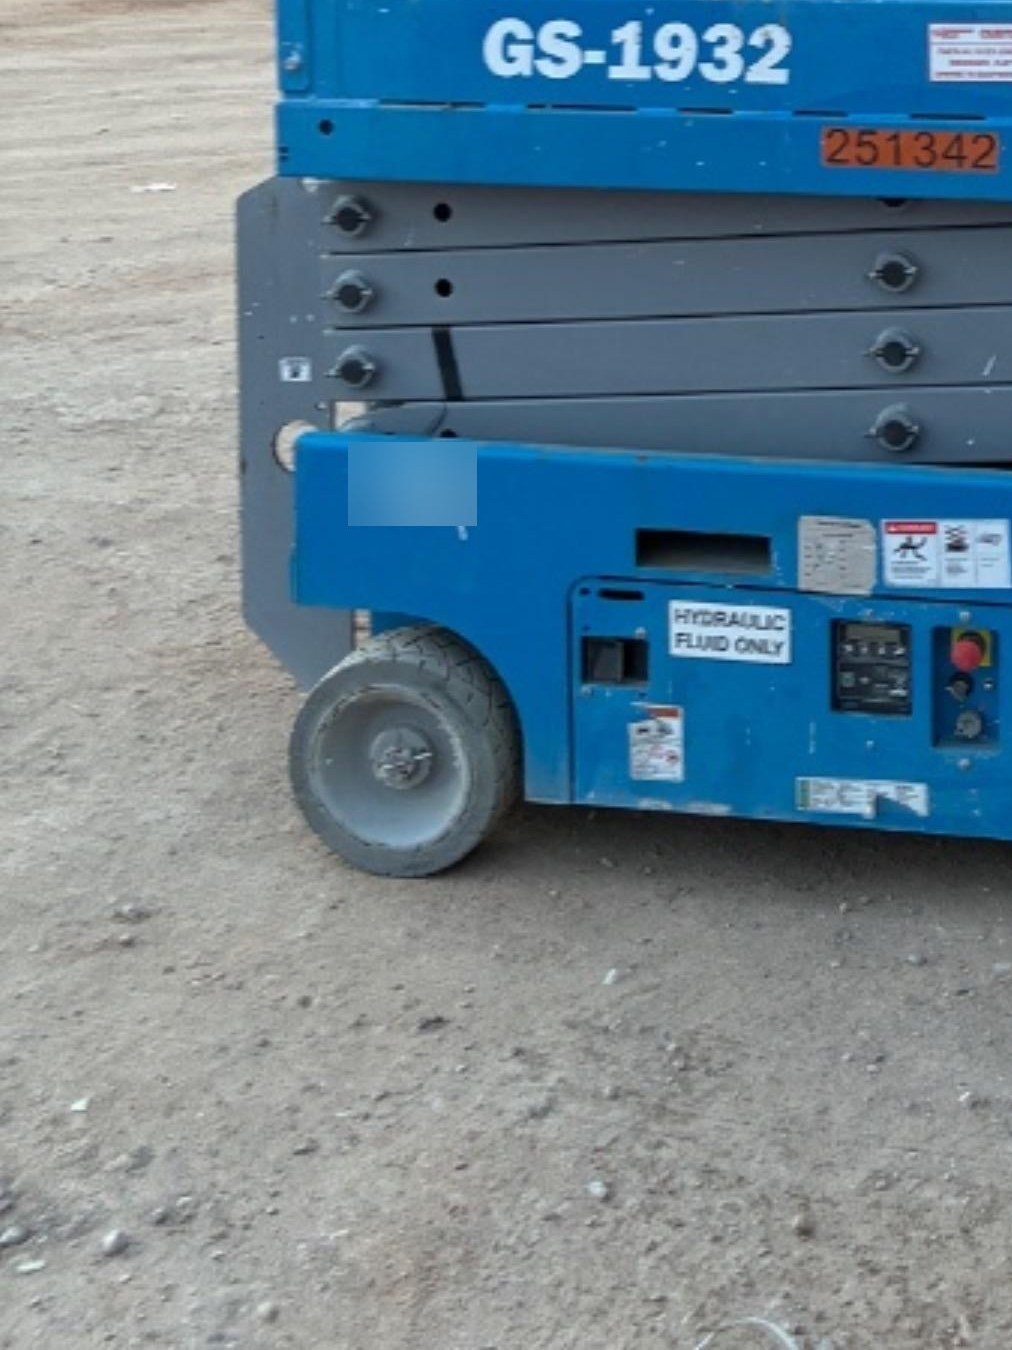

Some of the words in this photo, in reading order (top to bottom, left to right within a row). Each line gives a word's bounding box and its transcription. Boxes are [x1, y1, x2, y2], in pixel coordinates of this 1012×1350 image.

[482, 17, 792, 84] GS-1932
[824, 127, 997, 169] 251342
[674, 609, 786, 631] HYDRAULIC
[674, 632, 729, 652] FLUID
[734, 637, 784, 657] ONLY
